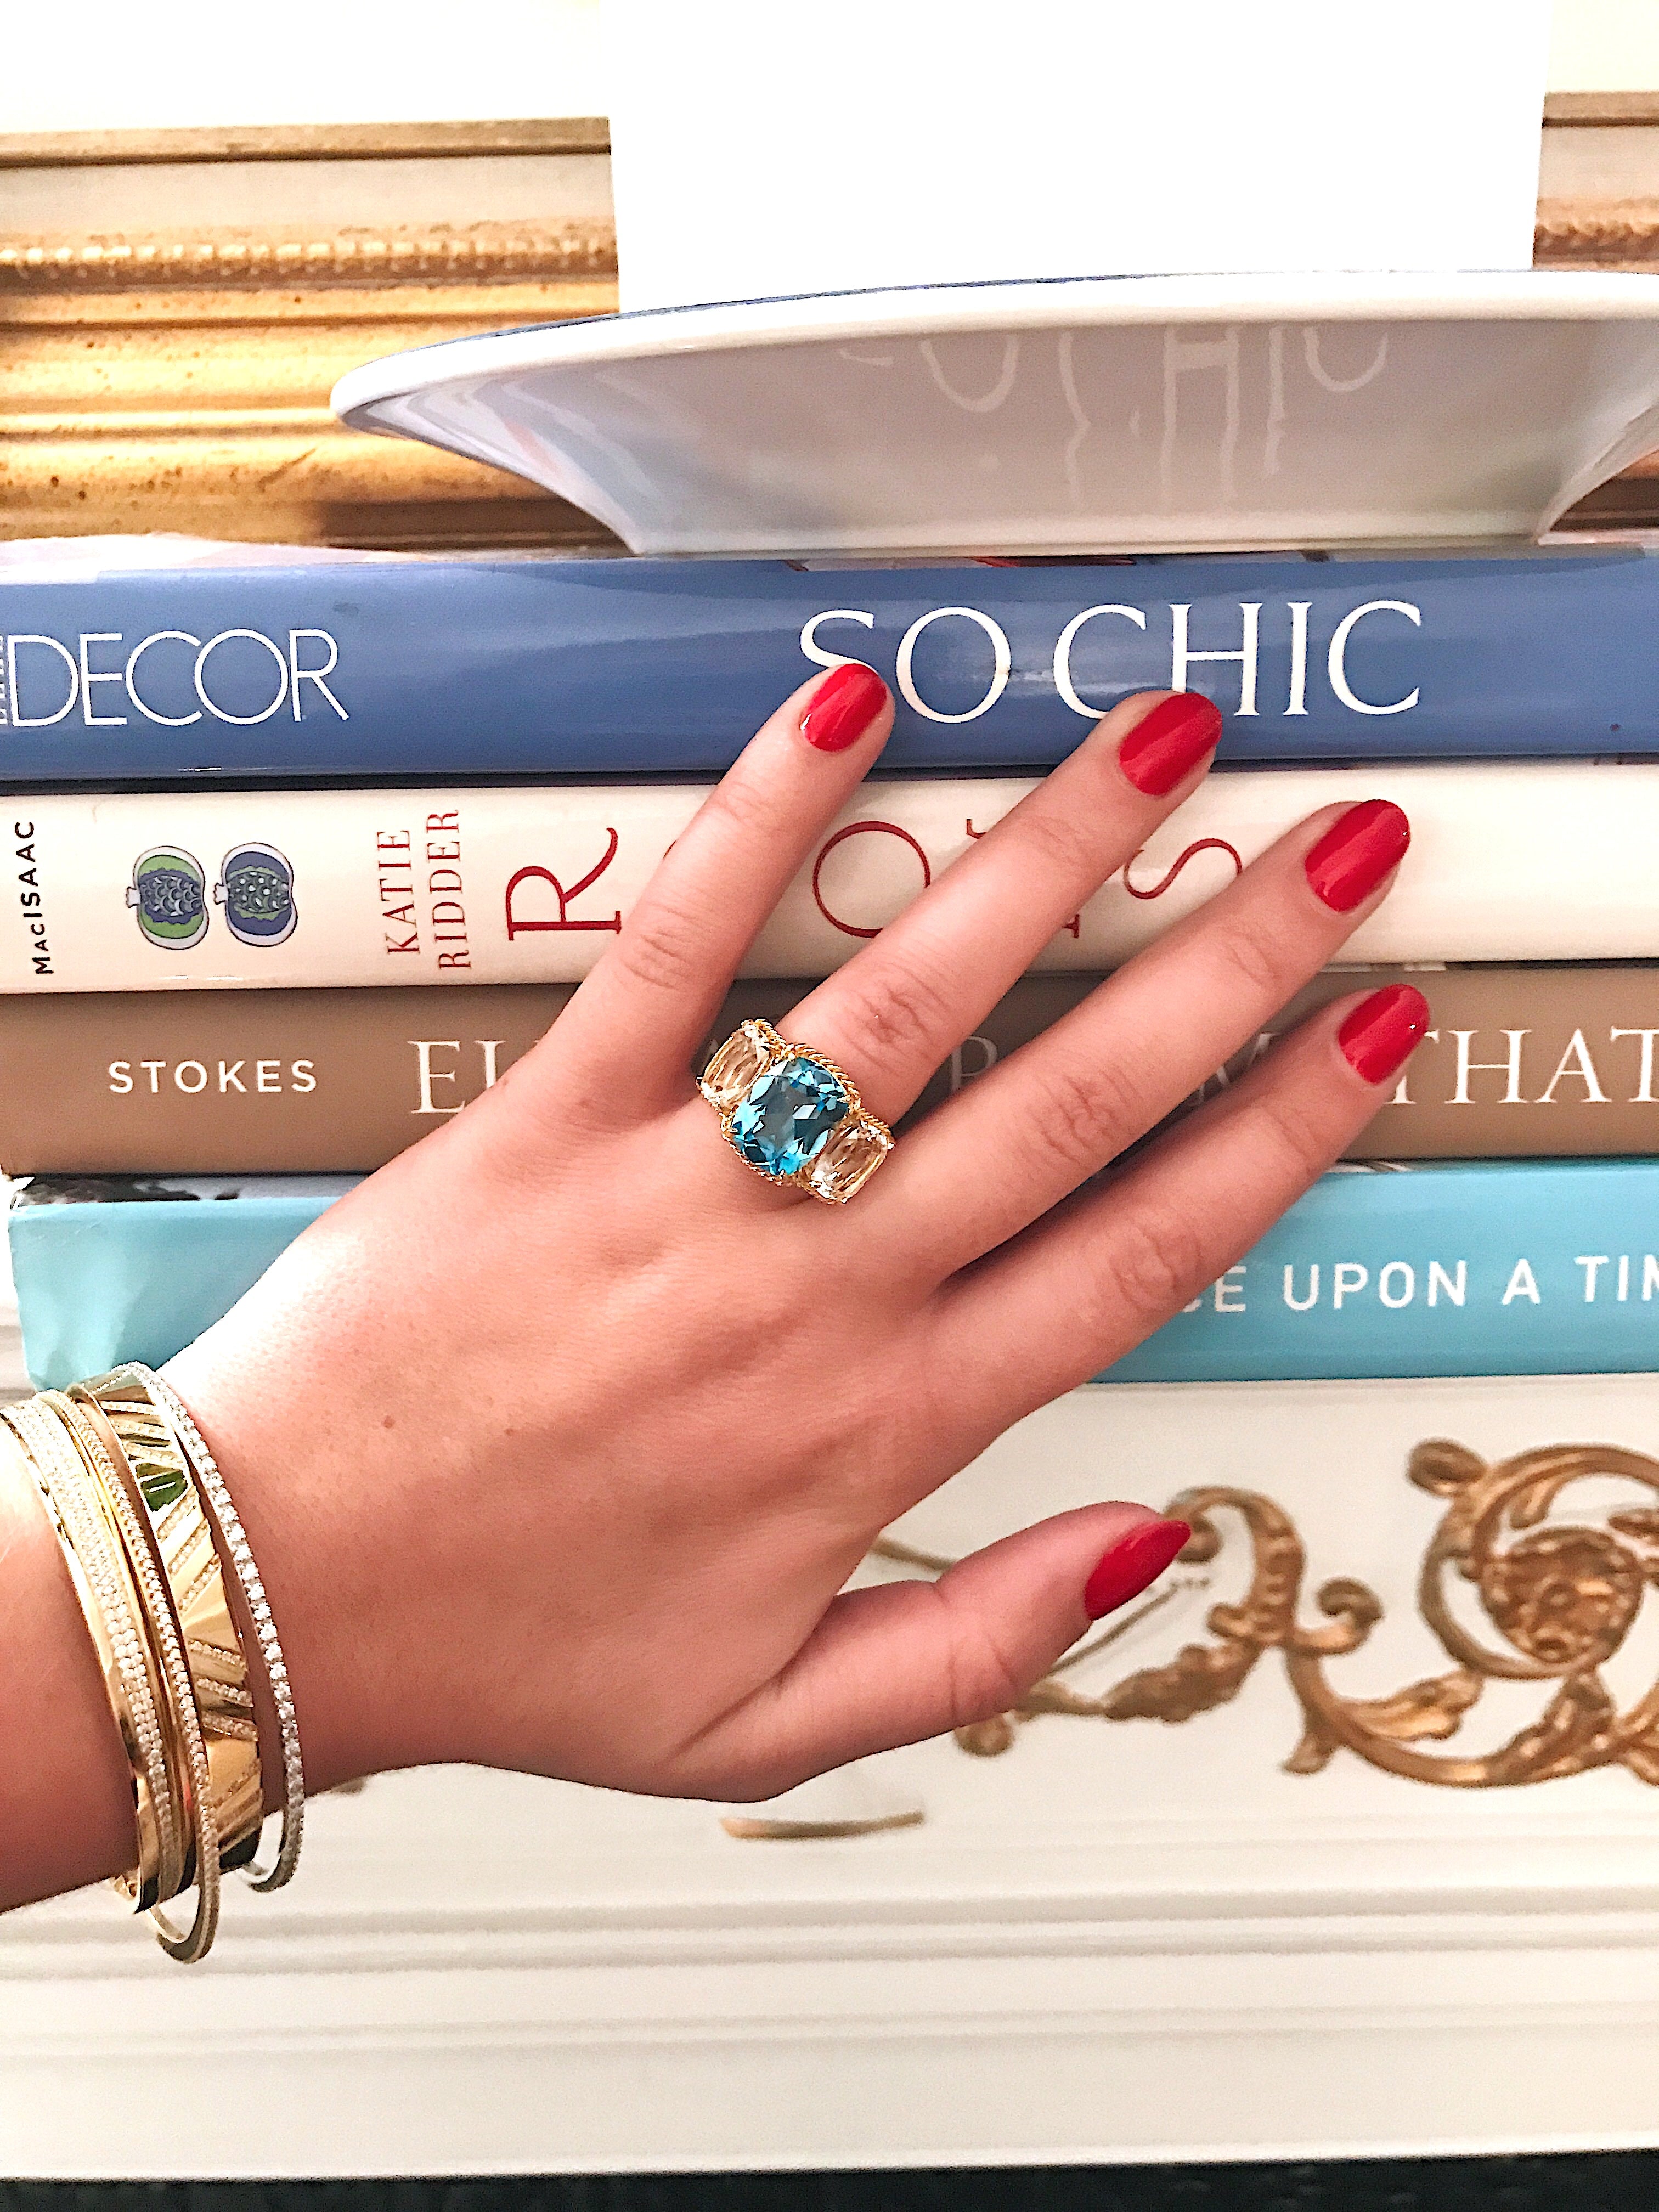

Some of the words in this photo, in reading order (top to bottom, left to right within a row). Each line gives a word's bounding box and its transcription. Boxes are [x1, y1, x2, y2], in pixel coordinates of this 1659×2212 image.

[7, 628, 350, 727] DECOR
[1052, 600, 1422, 720] CHIC
[376, 830, 420, 955] KATIE
[426, 809, 472, 970] RIDDER
[108, 1059, 317, 1094] STOKES
[1283, 1260, 1469, 1312] UPON
[1501, 1257, 1541, 1306] A
